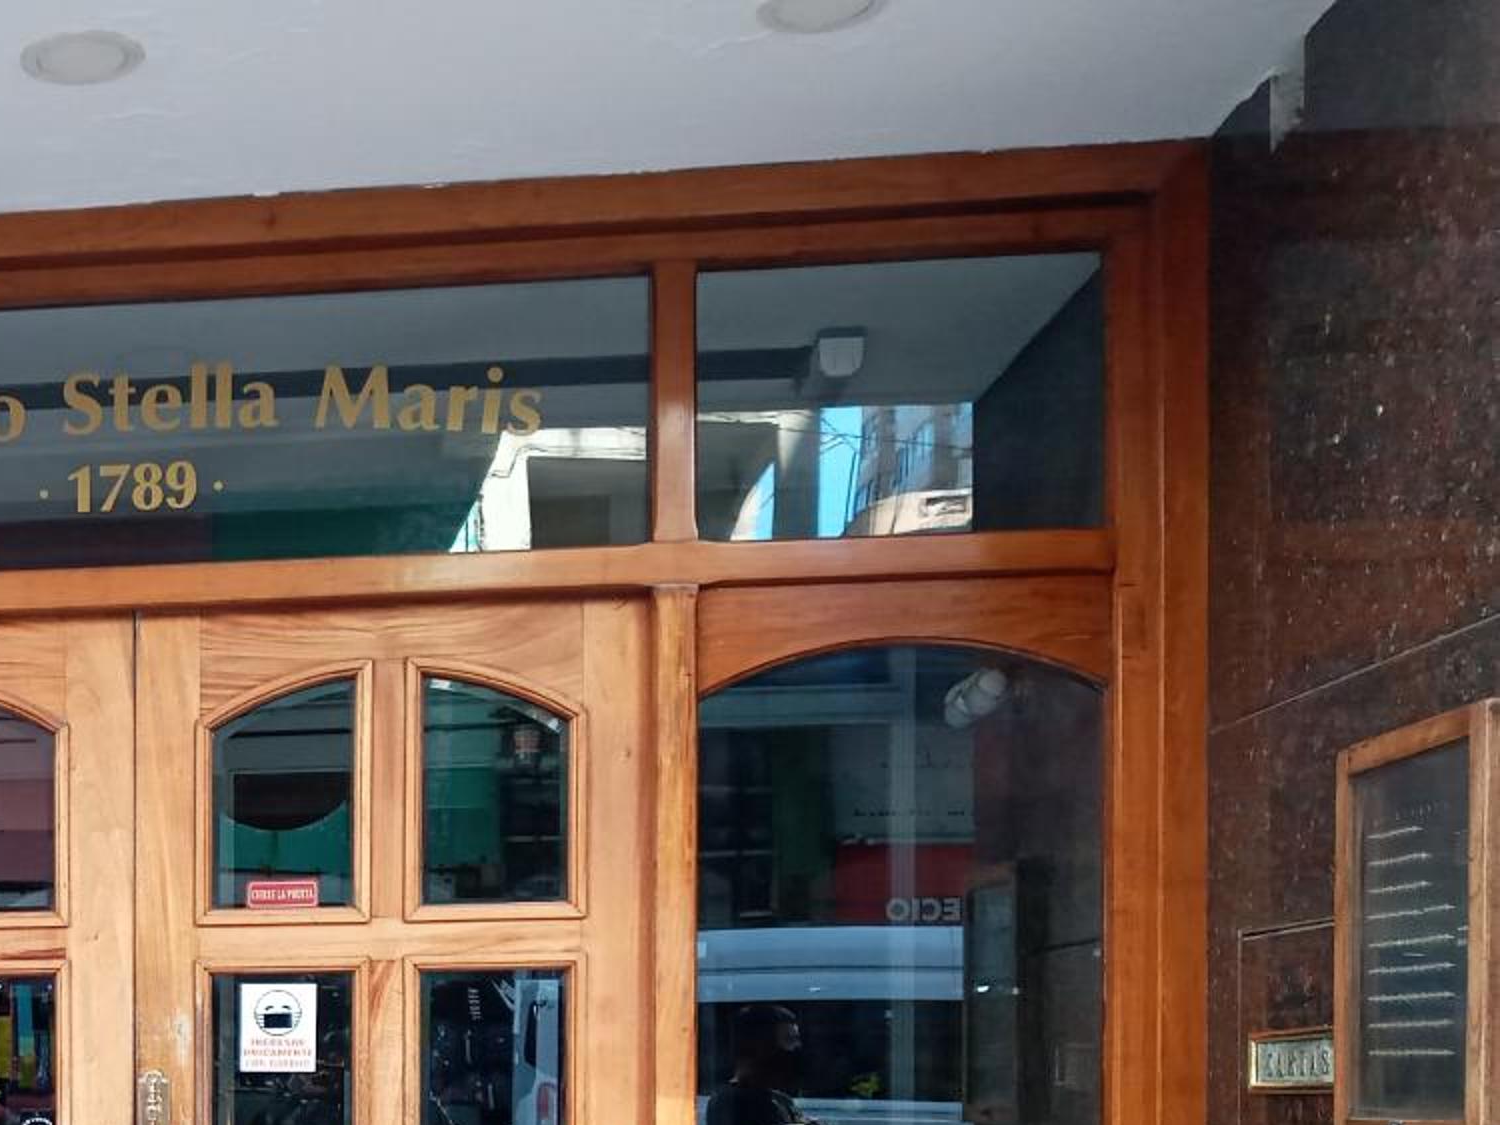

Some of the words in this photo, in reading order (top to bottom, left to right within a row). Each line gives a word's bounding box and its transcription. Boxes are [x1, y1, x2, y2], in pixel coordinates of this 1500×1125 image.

[62, 361, 279, 436] Stella
[313, 363, 543, 436] Maris
[67, 460, 198, 514] 1789
